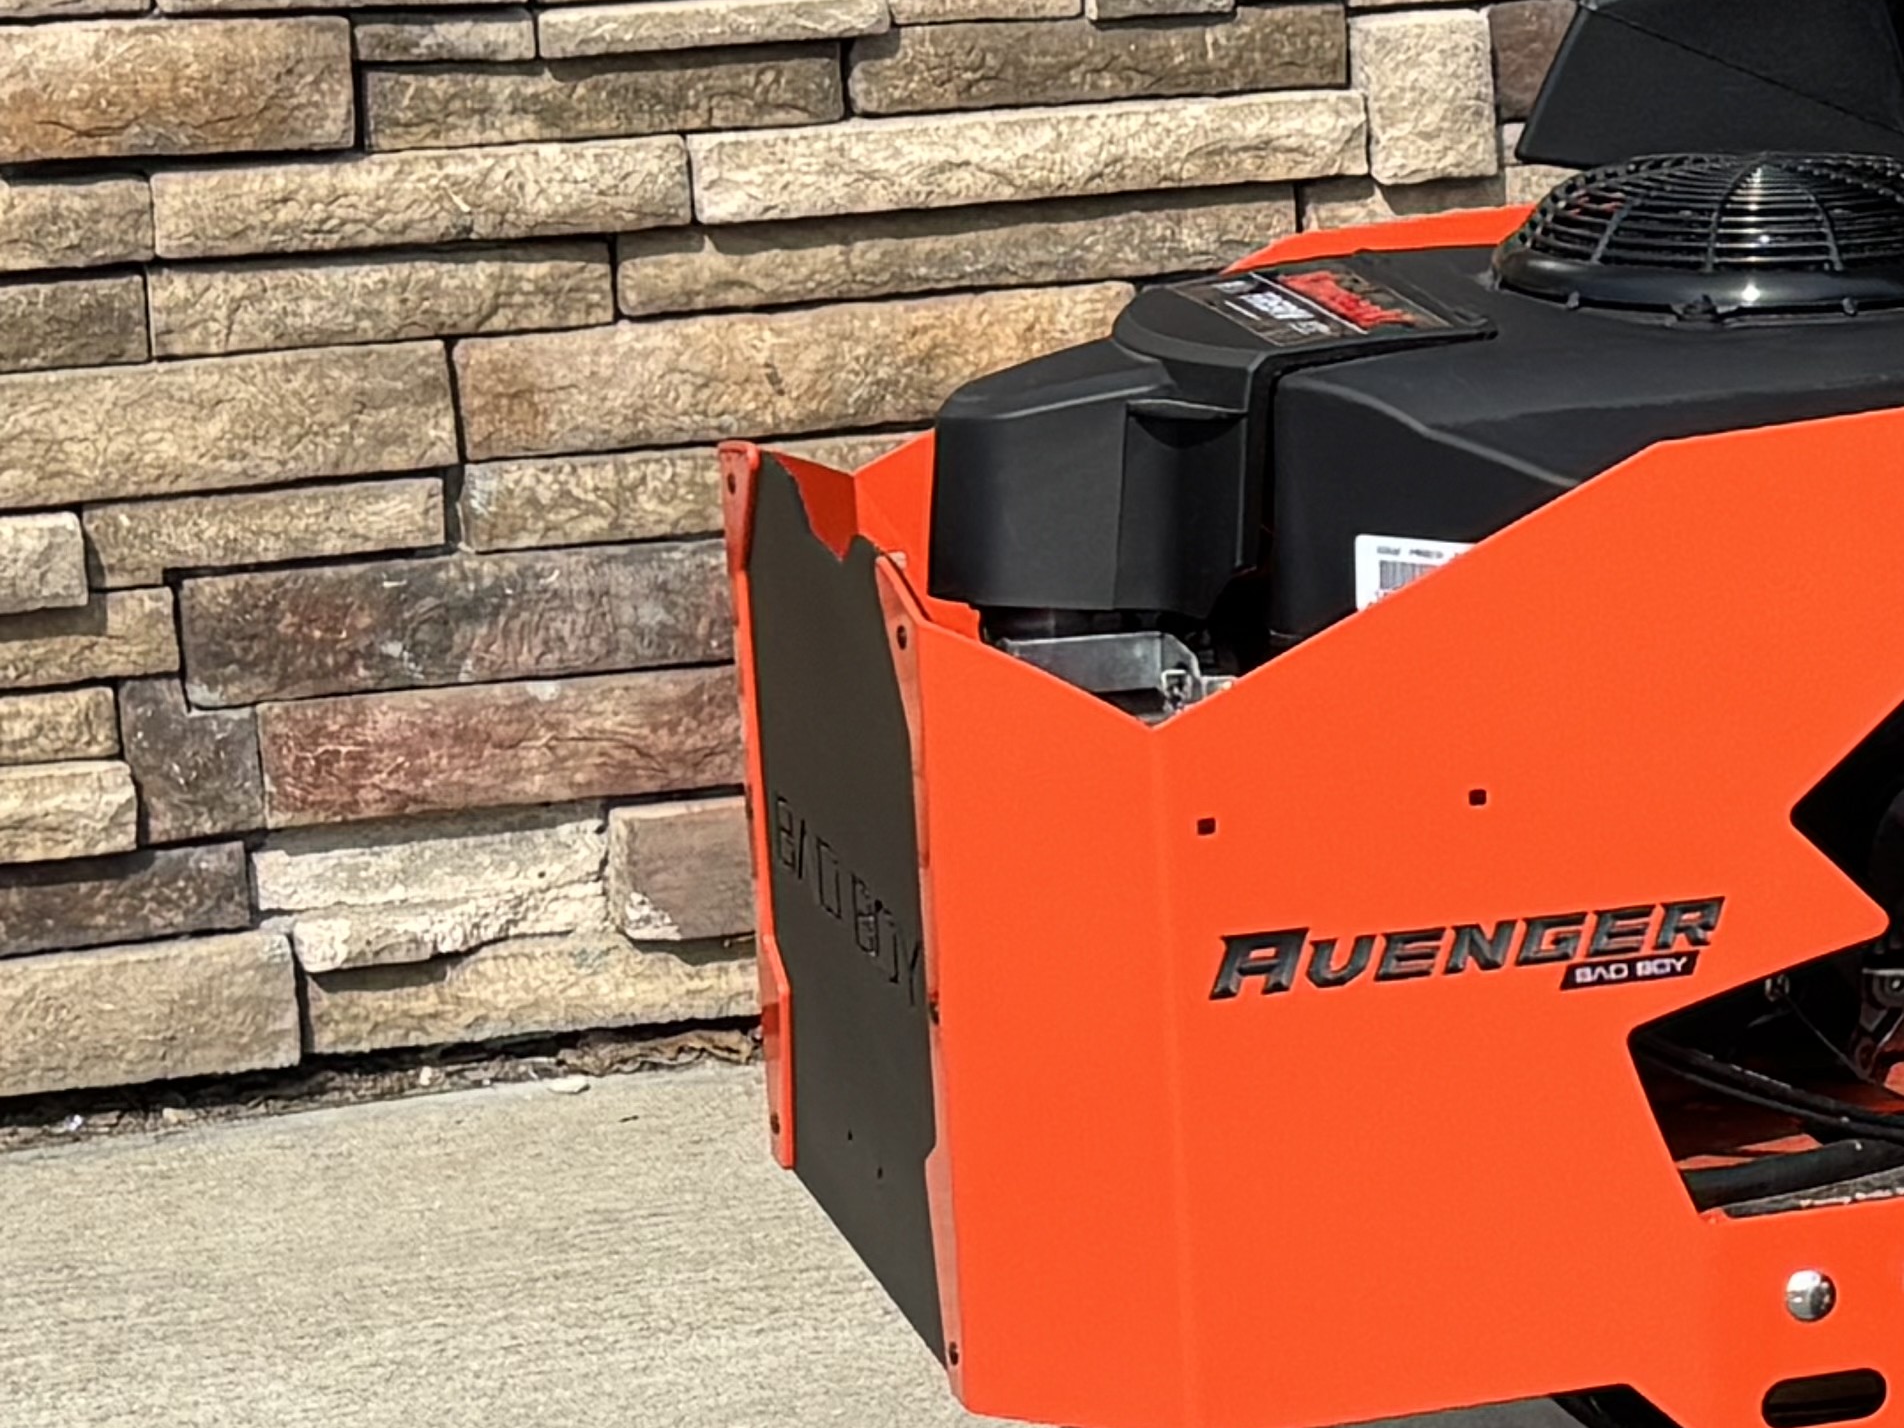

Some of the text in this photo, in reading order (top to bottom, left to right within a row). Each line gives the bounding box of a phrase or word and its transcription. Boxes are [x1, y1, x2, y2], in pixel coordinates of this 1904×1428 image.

[1208, 895, 1726, 1000] AVENGER
[1574, 956, 1688, 984] BAD BOY
